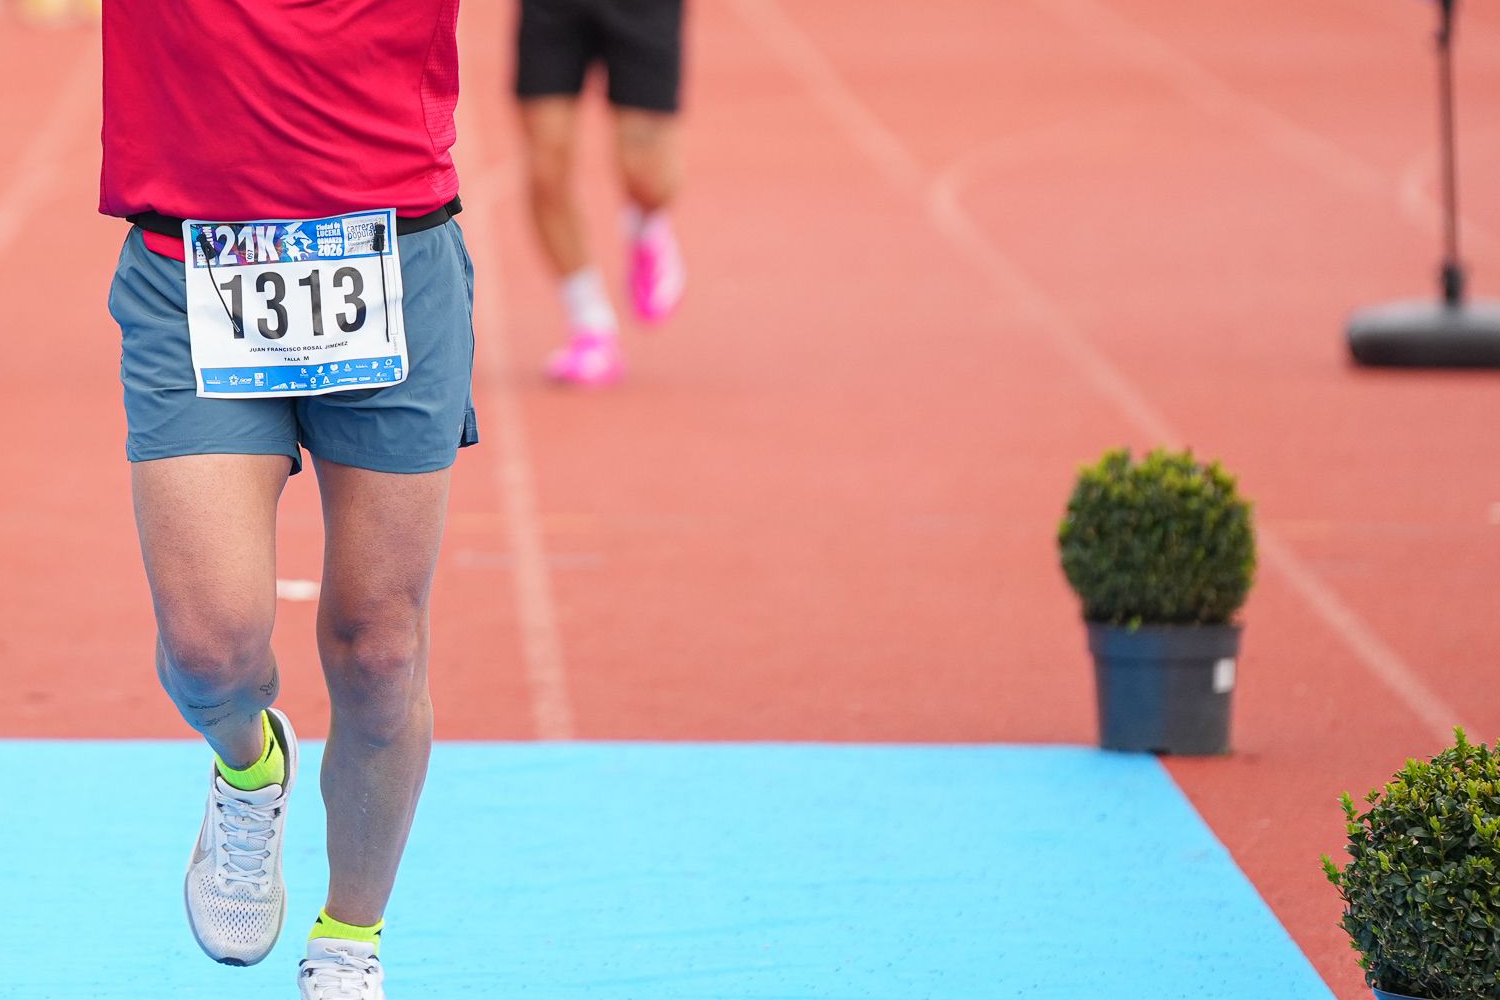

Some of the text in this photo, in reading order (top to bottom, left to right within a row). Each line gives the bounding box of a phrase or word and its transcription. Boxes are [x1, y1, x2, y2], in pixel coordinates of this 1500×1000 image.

[215, 225, 280, 264] 21K
[317, 228, 341, 237] LUCENA
[317, 244, 343, 256] 2026
[220, 266, 367, 340] 1313
